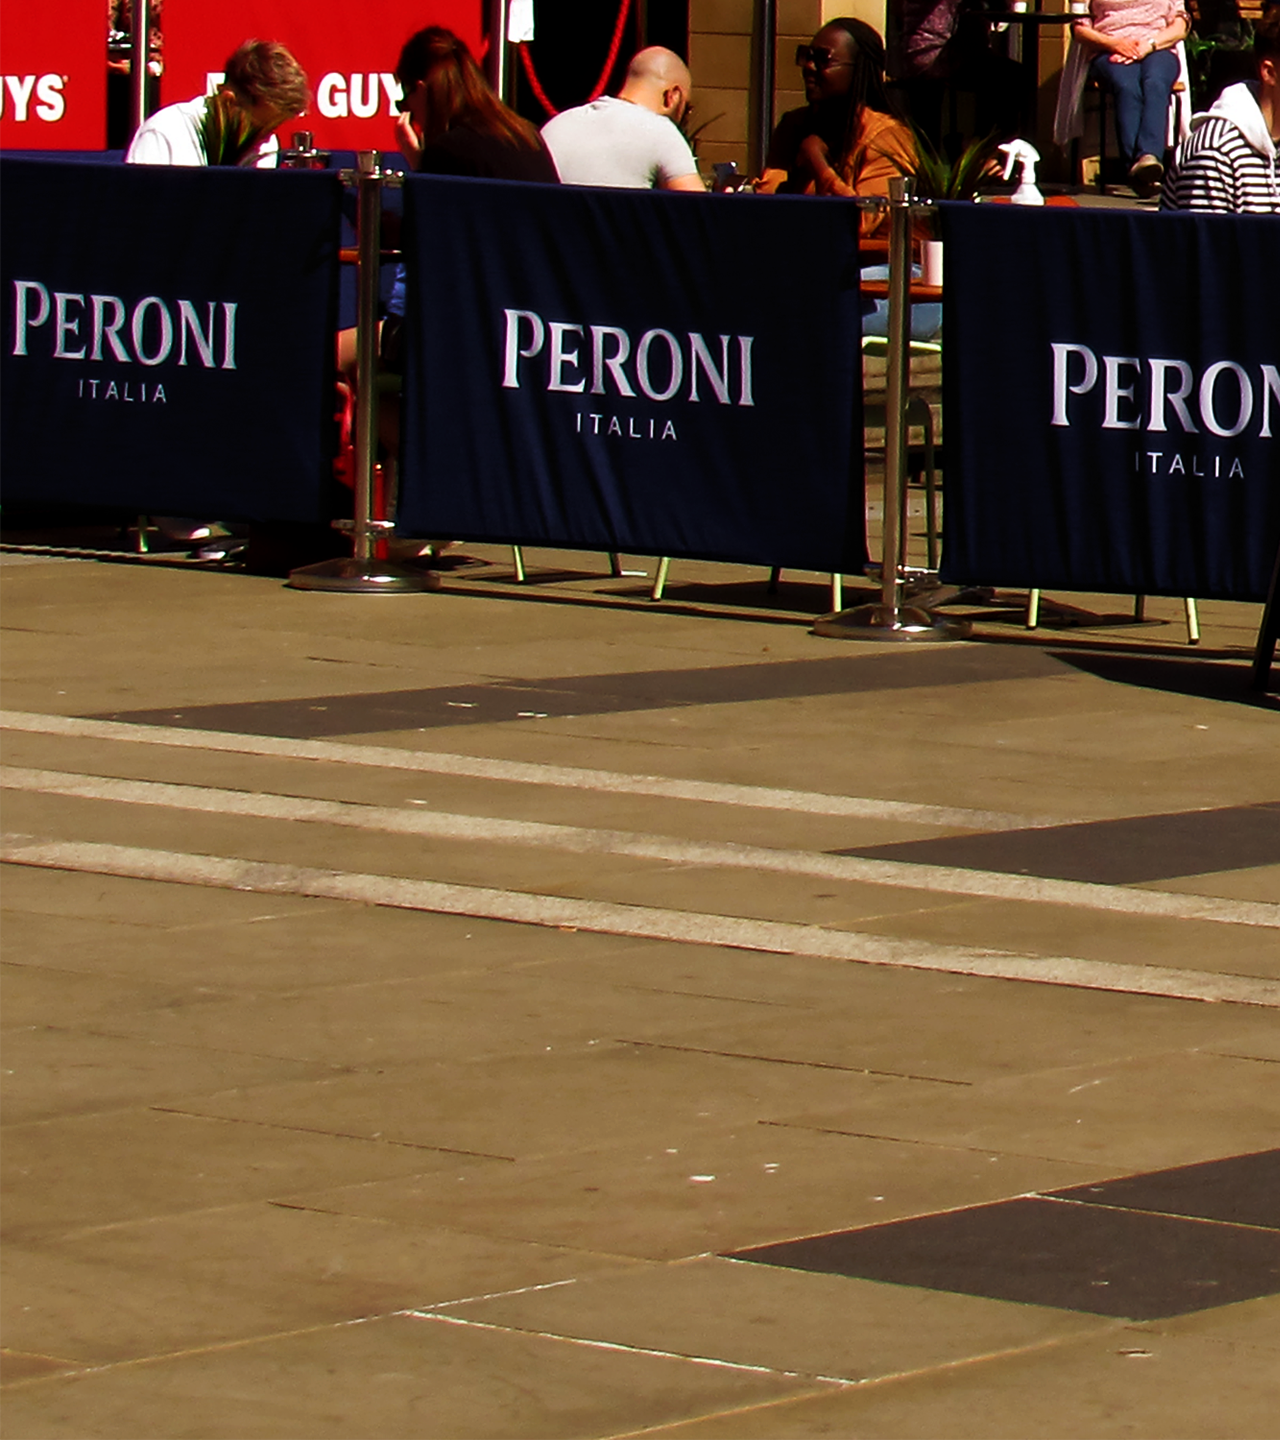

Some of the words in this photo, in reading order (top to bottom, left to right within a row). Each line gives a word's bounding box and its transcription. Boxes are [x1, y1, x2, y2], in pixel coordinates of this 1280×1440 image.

[0, 72, 67, 122] YS
[316, 71, 406, 119] GUY
[10, 278, 240, 371] PERONI
[500, 308, 756, 408] PERONI
[77, 378, 168, 404] ITALIA
[575, 412, 679, 442] ITALIA
[1133, 451, 1245, 480] ITALIA
